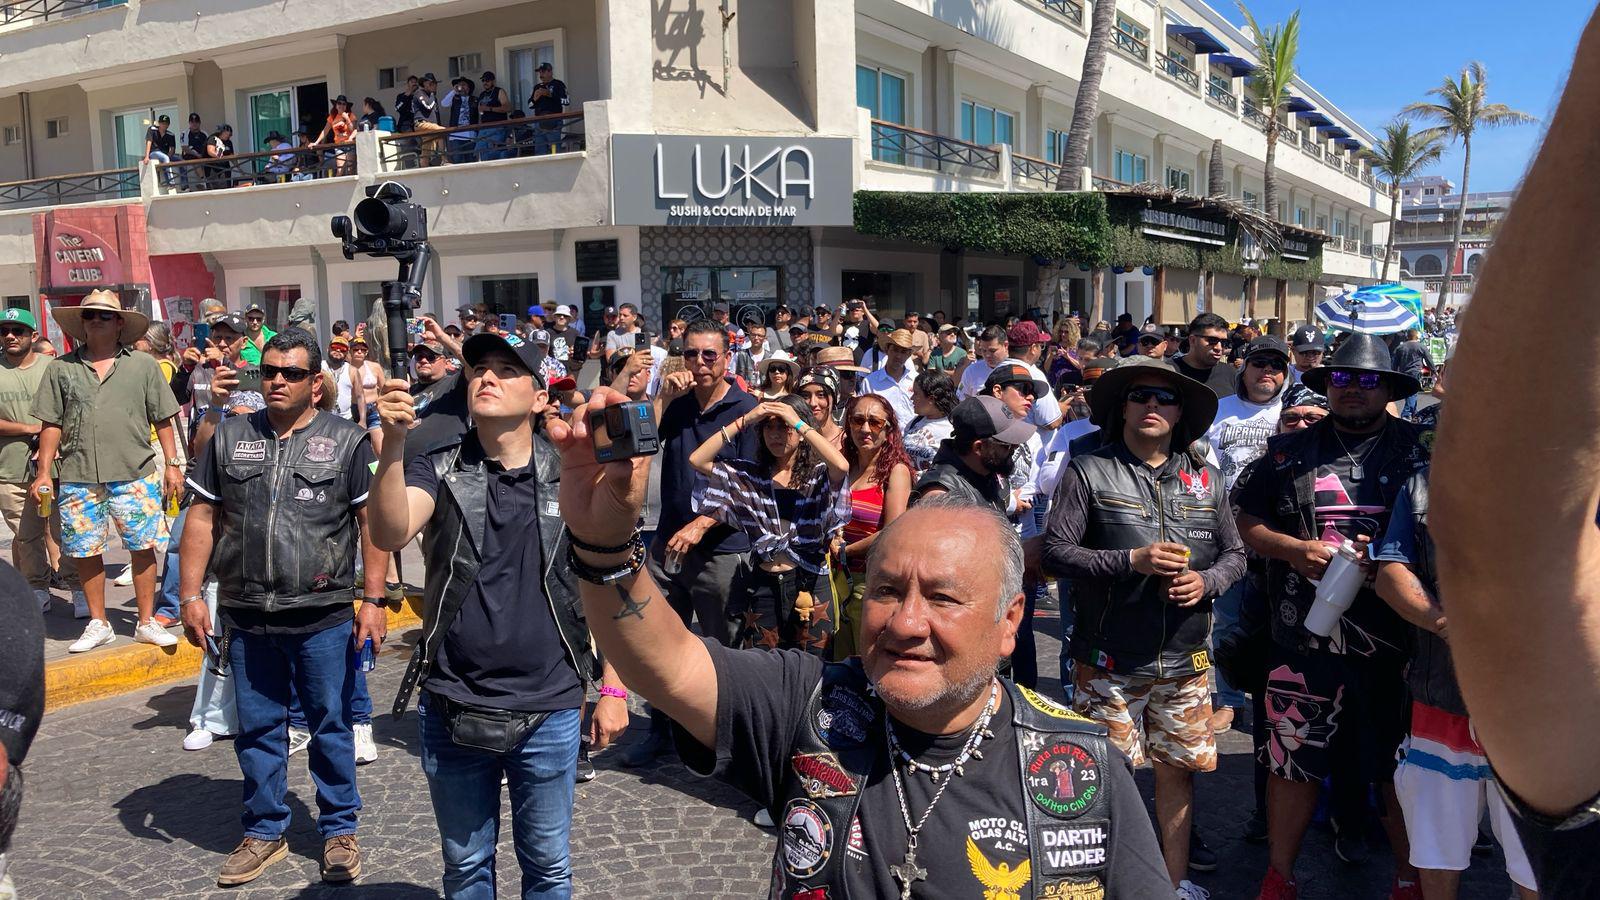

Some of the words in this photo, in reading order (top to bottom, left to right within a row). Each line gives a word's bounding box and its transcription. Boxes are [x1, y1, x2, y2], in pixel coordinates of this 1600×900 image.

[656, 142, 815, 200] LUKA
[670, 205, 702, 217] SUSHI
[703, 206, 711, 217] &
[712, 206, 757, 217] COCINA
[758, 207, 772, 217] DE
[774, 206, 797, 217] MAR
[56, 234, 83, 248] The
[54, 247, 104, 264] CAVERN
[68, 268, 102, 282] CLUB
[1188, 530, 1212, 539] ACOSTA
[1030, 750, 1052, 774] Ruta
[1052, 744, 1070, 755] del
[1071, 746, 1096, 769] REY
[1028, 775, 1049, 787] 1ra
[1080, 769, 1097, 781] 23
[968, 817, 1007, 832] MOTO
[1010, 820, 1027, 833] CL
[971, 827, 1002, 841] OLAS
[1046, 847, 1106, 868] VADER
